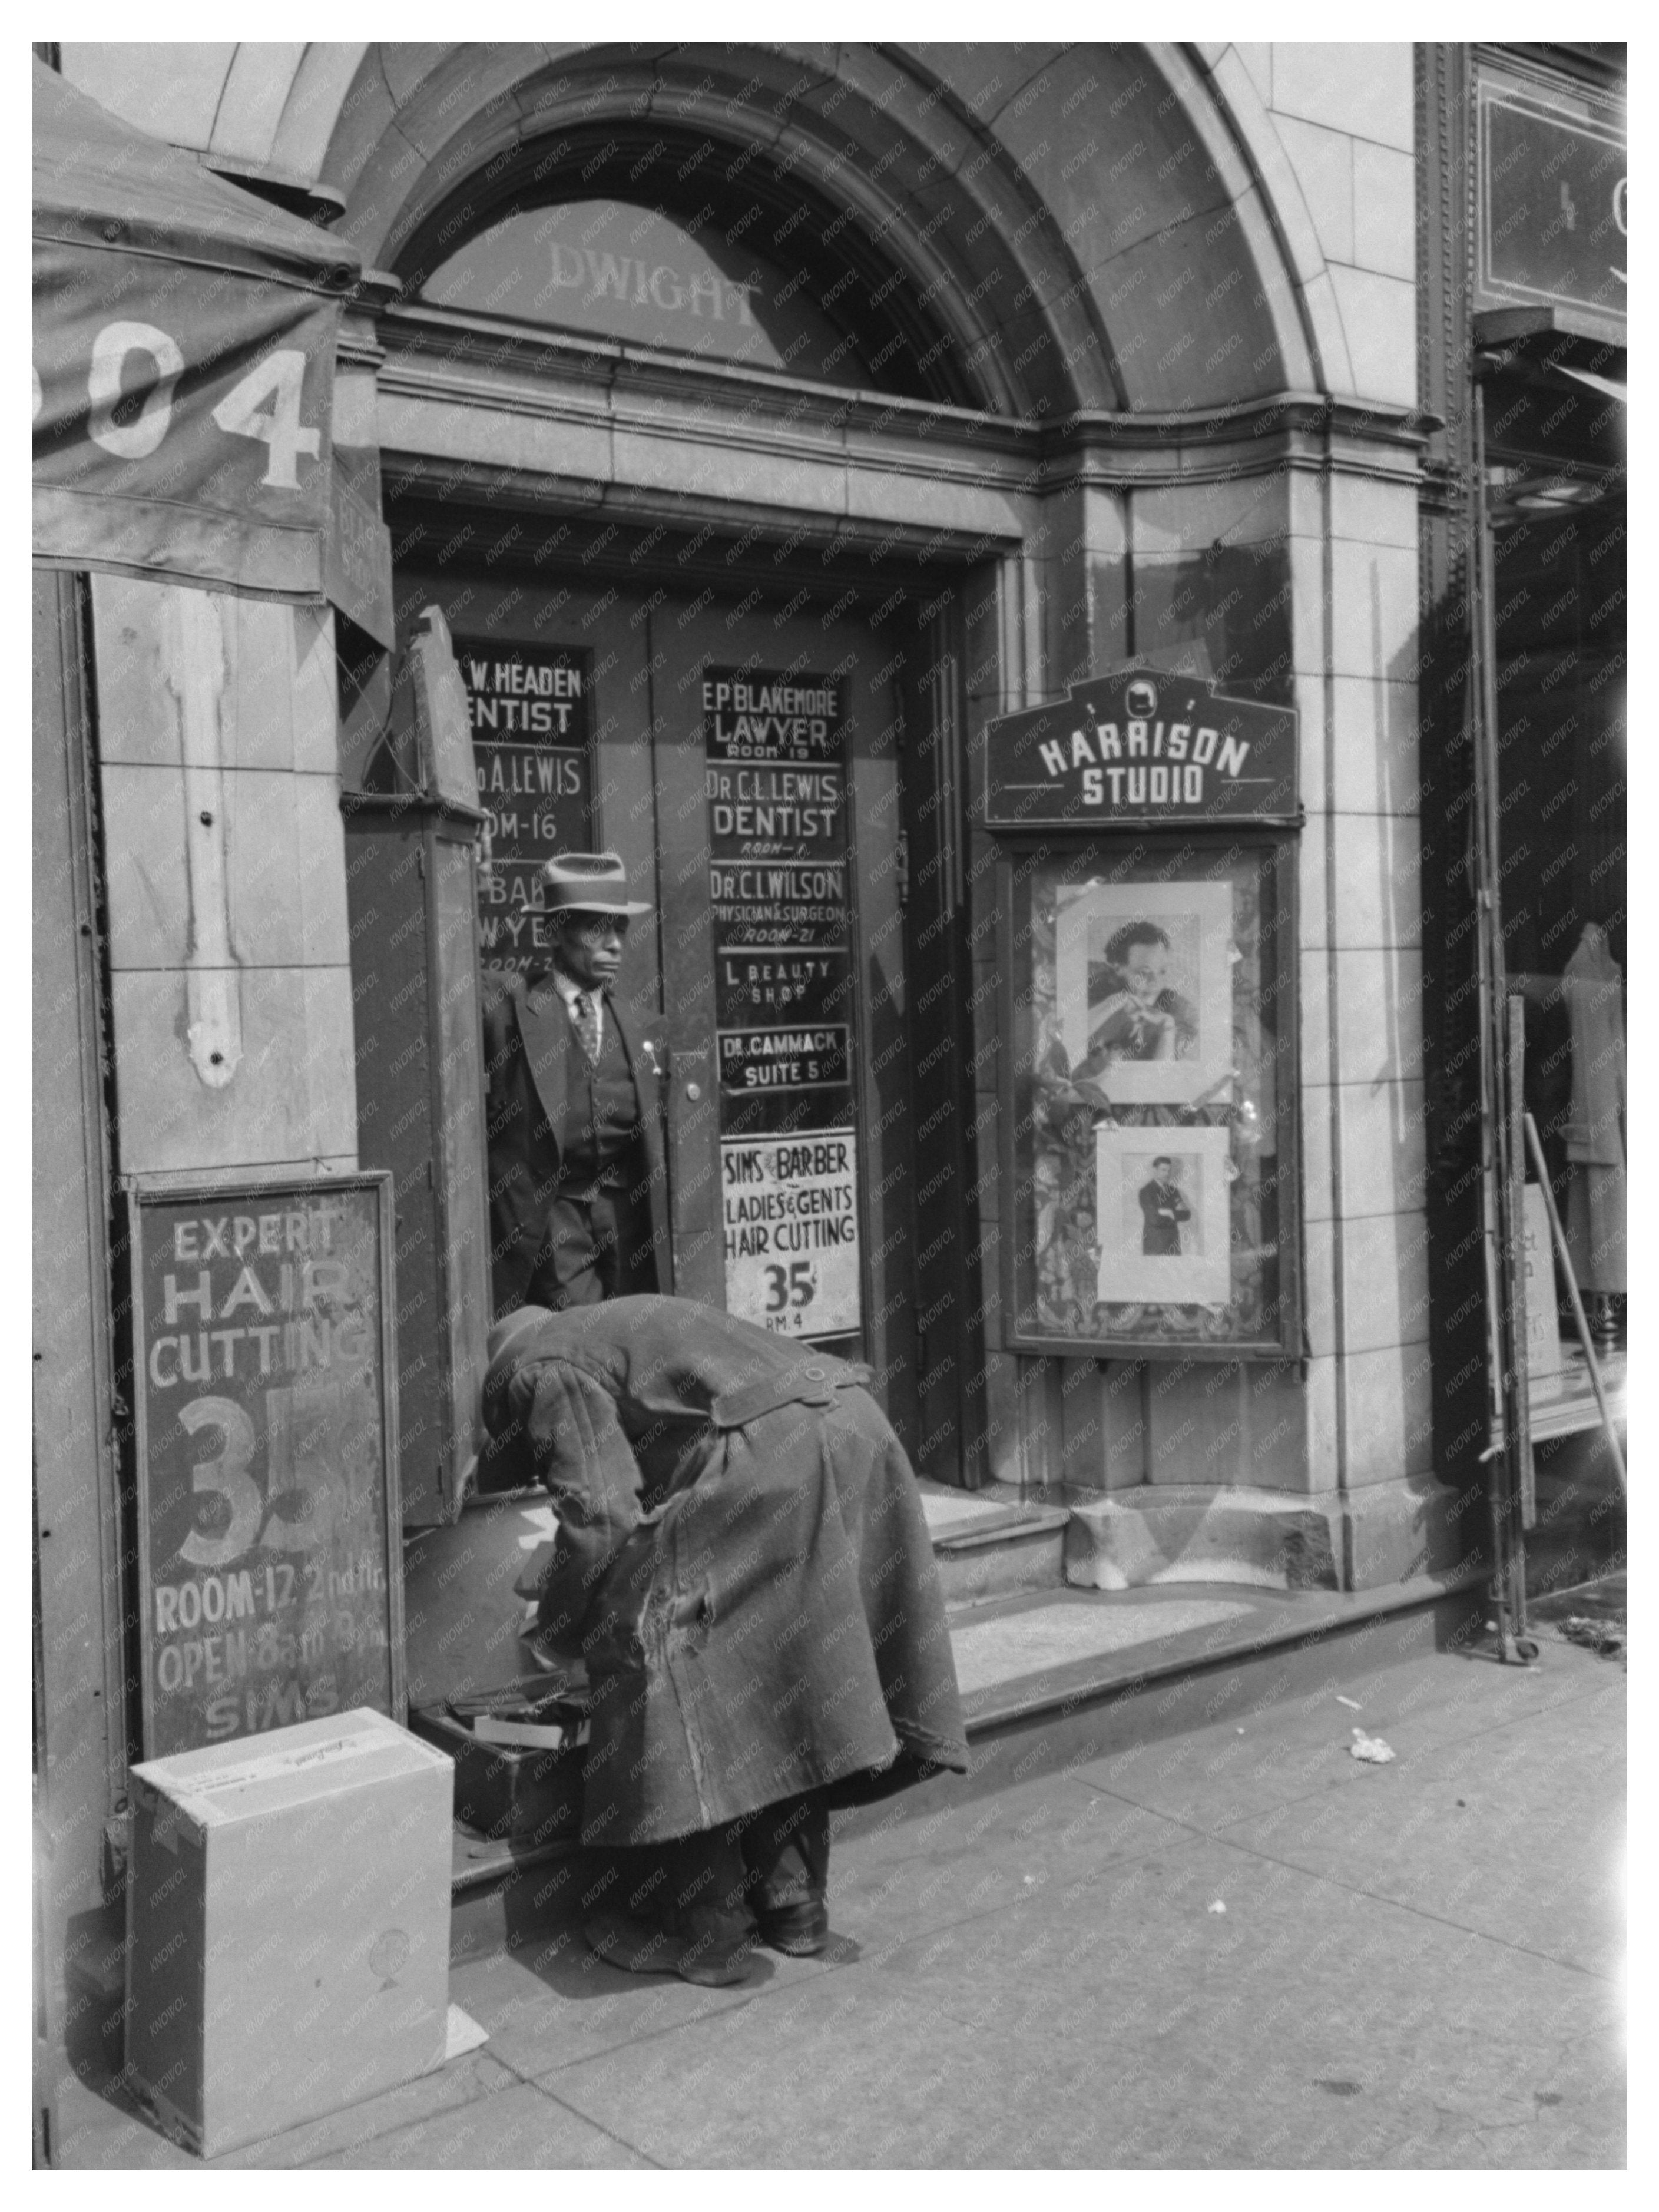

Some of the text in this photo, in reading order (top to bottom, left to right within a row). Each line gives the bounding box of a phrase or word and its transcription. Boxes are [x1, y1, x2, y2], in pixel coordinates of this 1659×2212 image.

[550, 241, 762, 326] DWIGHT
[32, 320, 321, 490] 04
[715, 714, 827, 747] LAWYER
[727, 744, 809, 759] ROOM 19
[1039, 720, 1250, 777] HARRISON
[1082, 765, 1203, 805] STUDIO
[714, 805, 837, 837] DENTIST
[748, 961, 829, 982] BEAUTY
[751, 985, 806, 1004] SHOP
[744, 1059, 819, 1087] SUITE 5
[725, 1143, 850, 1185] SIMS BARBER
[174, 1210, 338, 1261] EXPERT
[725, 1215, 855, 1259] HAIR CUTTING
[164, 1261, 355, 1324] HAIR
[794, 1313, 802, 1329] 4
[150, 1317, 370, 1388] CUTTING
[206, 1674, 340, 1739] SIMS
